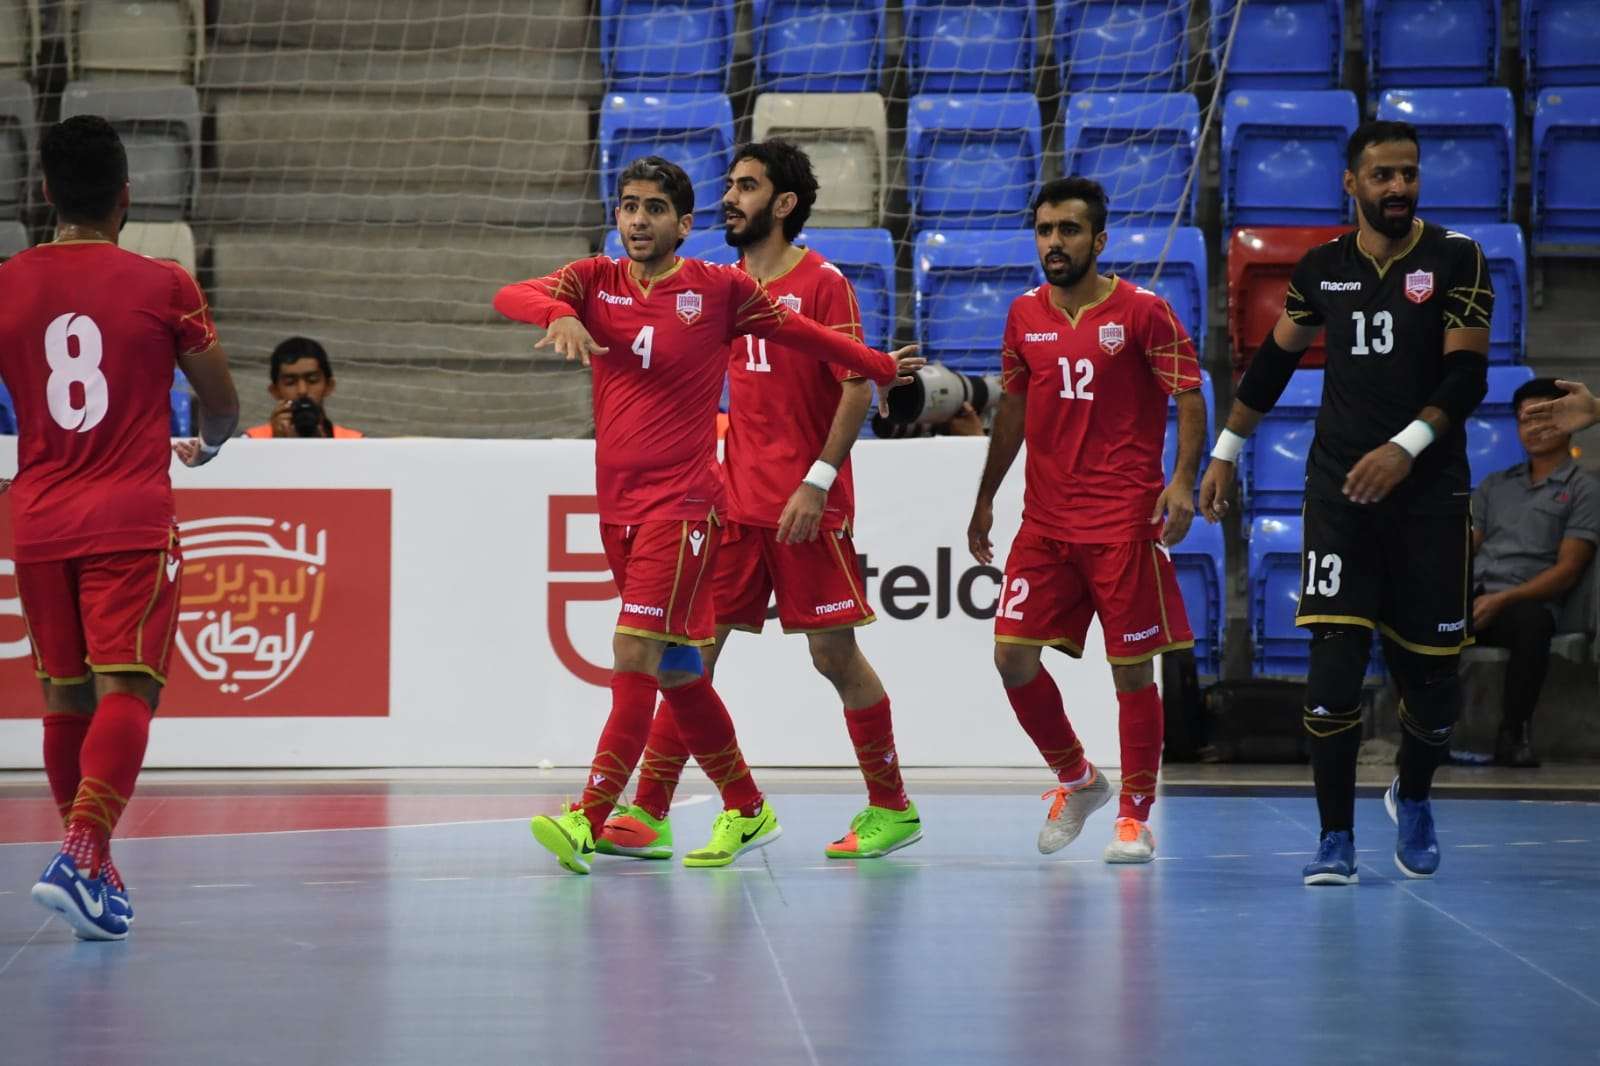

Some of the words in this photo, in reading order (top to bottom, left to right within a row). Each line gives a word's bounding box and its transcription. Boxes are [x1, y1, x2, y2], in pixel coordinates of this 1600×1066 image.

[1320, 280, 1362, 291] macron
[631, 325, 655, 370] 4
[743, 333, 771, 373] 11
[1024, 331, 1058, 342] macron
[1351, 310, 1394, 355] 13
[44, 312, 109, 433] 8
[1057, 356, 1095, 401] 12
[856, 546, 1004, 621] telc
[1305, 550, 1343, 598] 13
[624, 601, 664, 617] macron
[815, 598, 855, 616] macron
[995, 574, 1030, 621] 12
[1122, 623, 1160, 645] macron
[1438, 617, 1466, 633] mac
